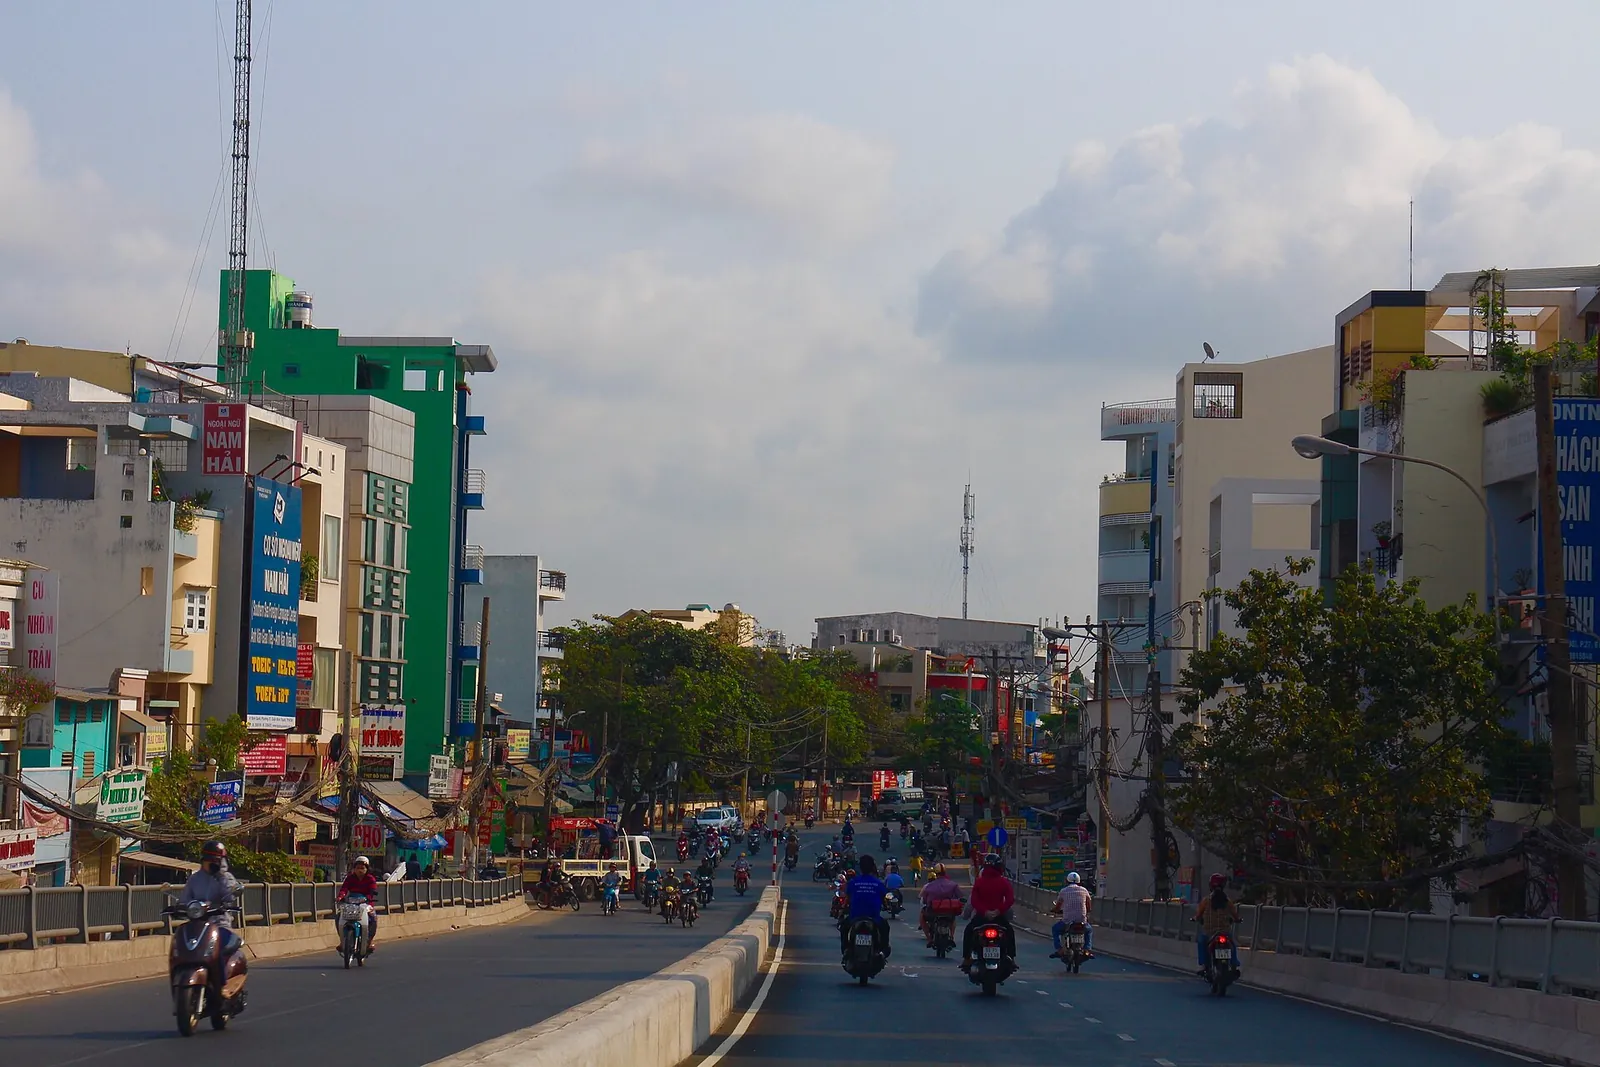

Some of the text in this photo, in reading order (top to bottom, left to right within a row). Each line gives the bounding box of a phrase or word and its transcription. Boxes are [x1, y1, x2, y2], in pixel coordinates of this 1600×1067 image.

[208, 418, 240, 428] NGOẠI NGỮ
[206, 432, 242, 448] NAM
[1554, 428, 1600, 472] HÁCH
[206, 450, 241, 472] HẢI
[1557, 484, 1590, 530] SẠN
[1562, 536, 1592, 582] ÌNH
[264, 568, 289, 596] NAM HẢI
[252, 656, 272, 674] TOEIC
[278, 659, 296, 676] IELTS
[256, 686, 276, 702] TOEFL
[278, 688, 290, 703] iBT
